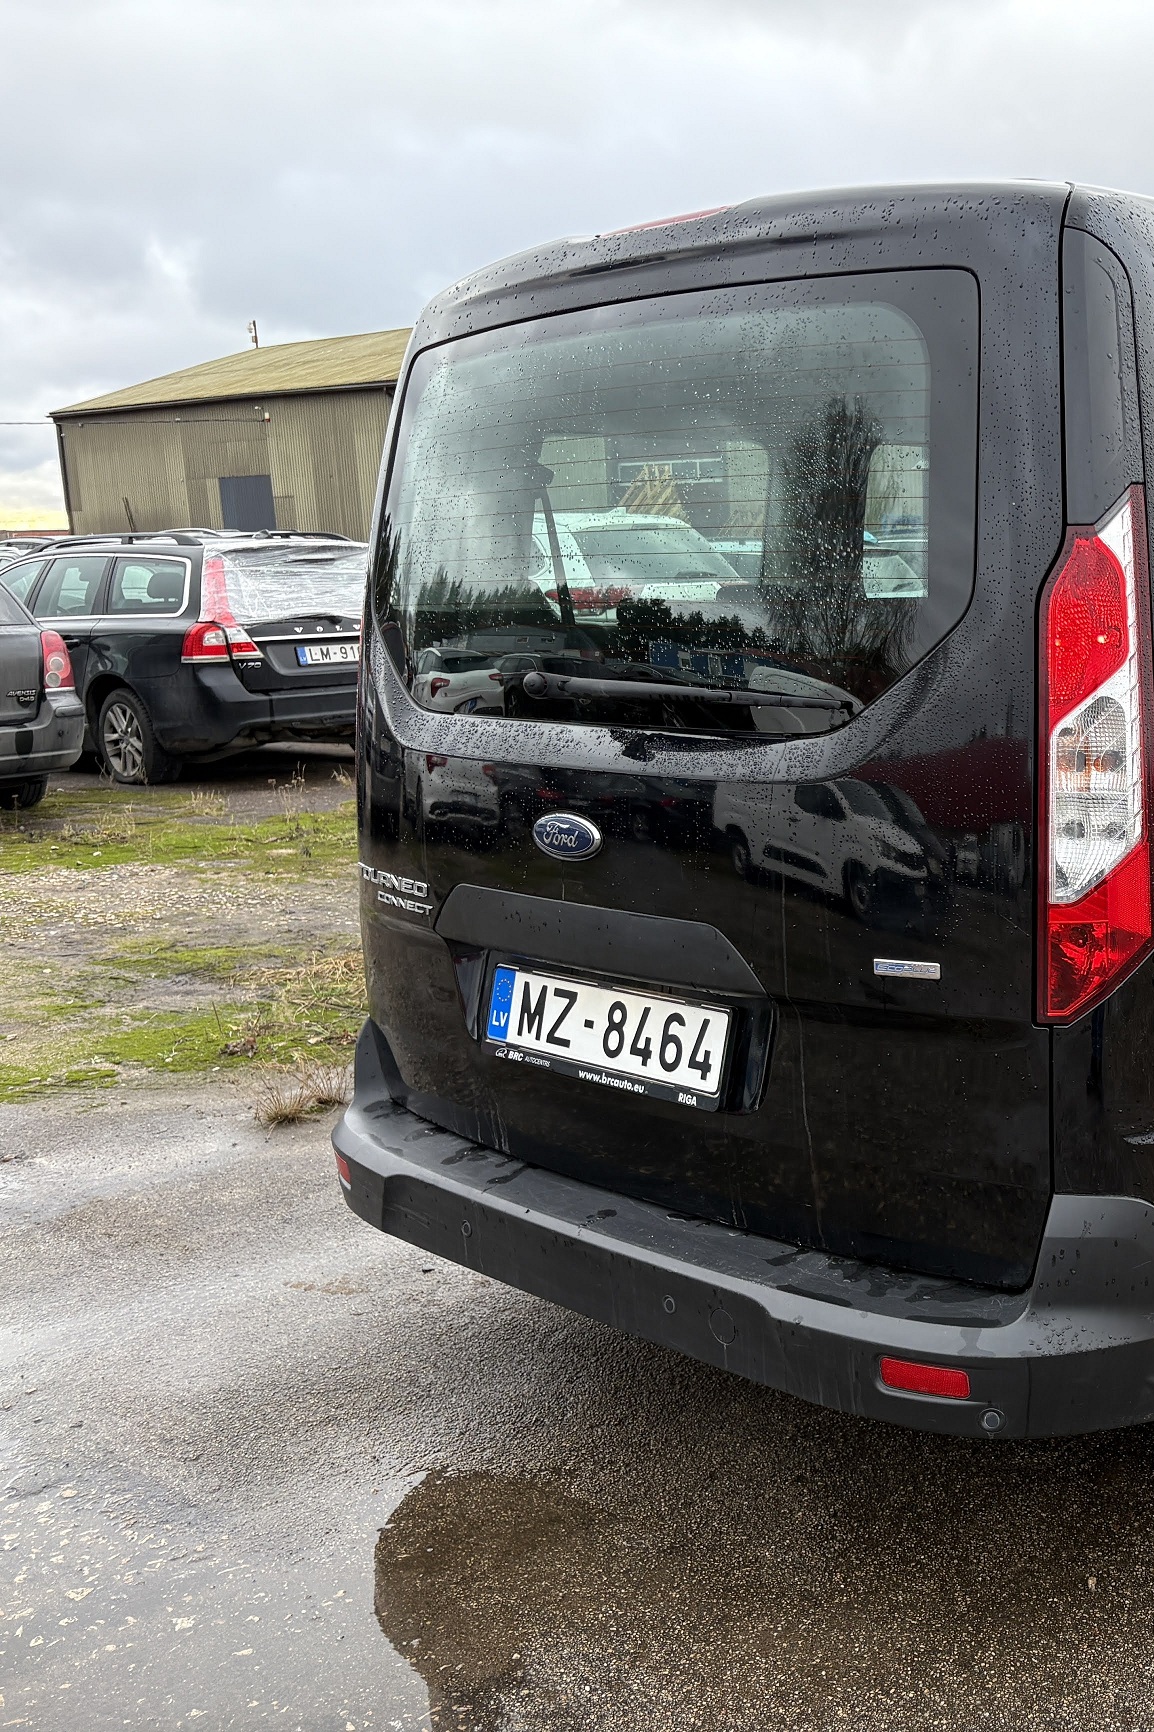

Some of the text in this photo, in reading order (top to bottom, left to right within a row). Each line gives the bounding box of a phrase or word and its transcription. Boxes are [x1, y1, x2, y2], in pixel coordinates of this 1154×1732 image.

[294, 624, 361, 634] VOLV
[238, 661, 262, 669] V70
[6, 689, 37, 697] AVENSIS
[543, 821, 579, 848] Ford
[377, 890, 434, 916] CONNECT
[492, 1009, 508, 1028] LV
[516, 980, 713, 1081] MZ-8464
[507, 1050, 524, 1062] BRC
[578, 1069, 645, 1094] www.brcauto.eu
[678, 1092, 697, 1107] RIGA
